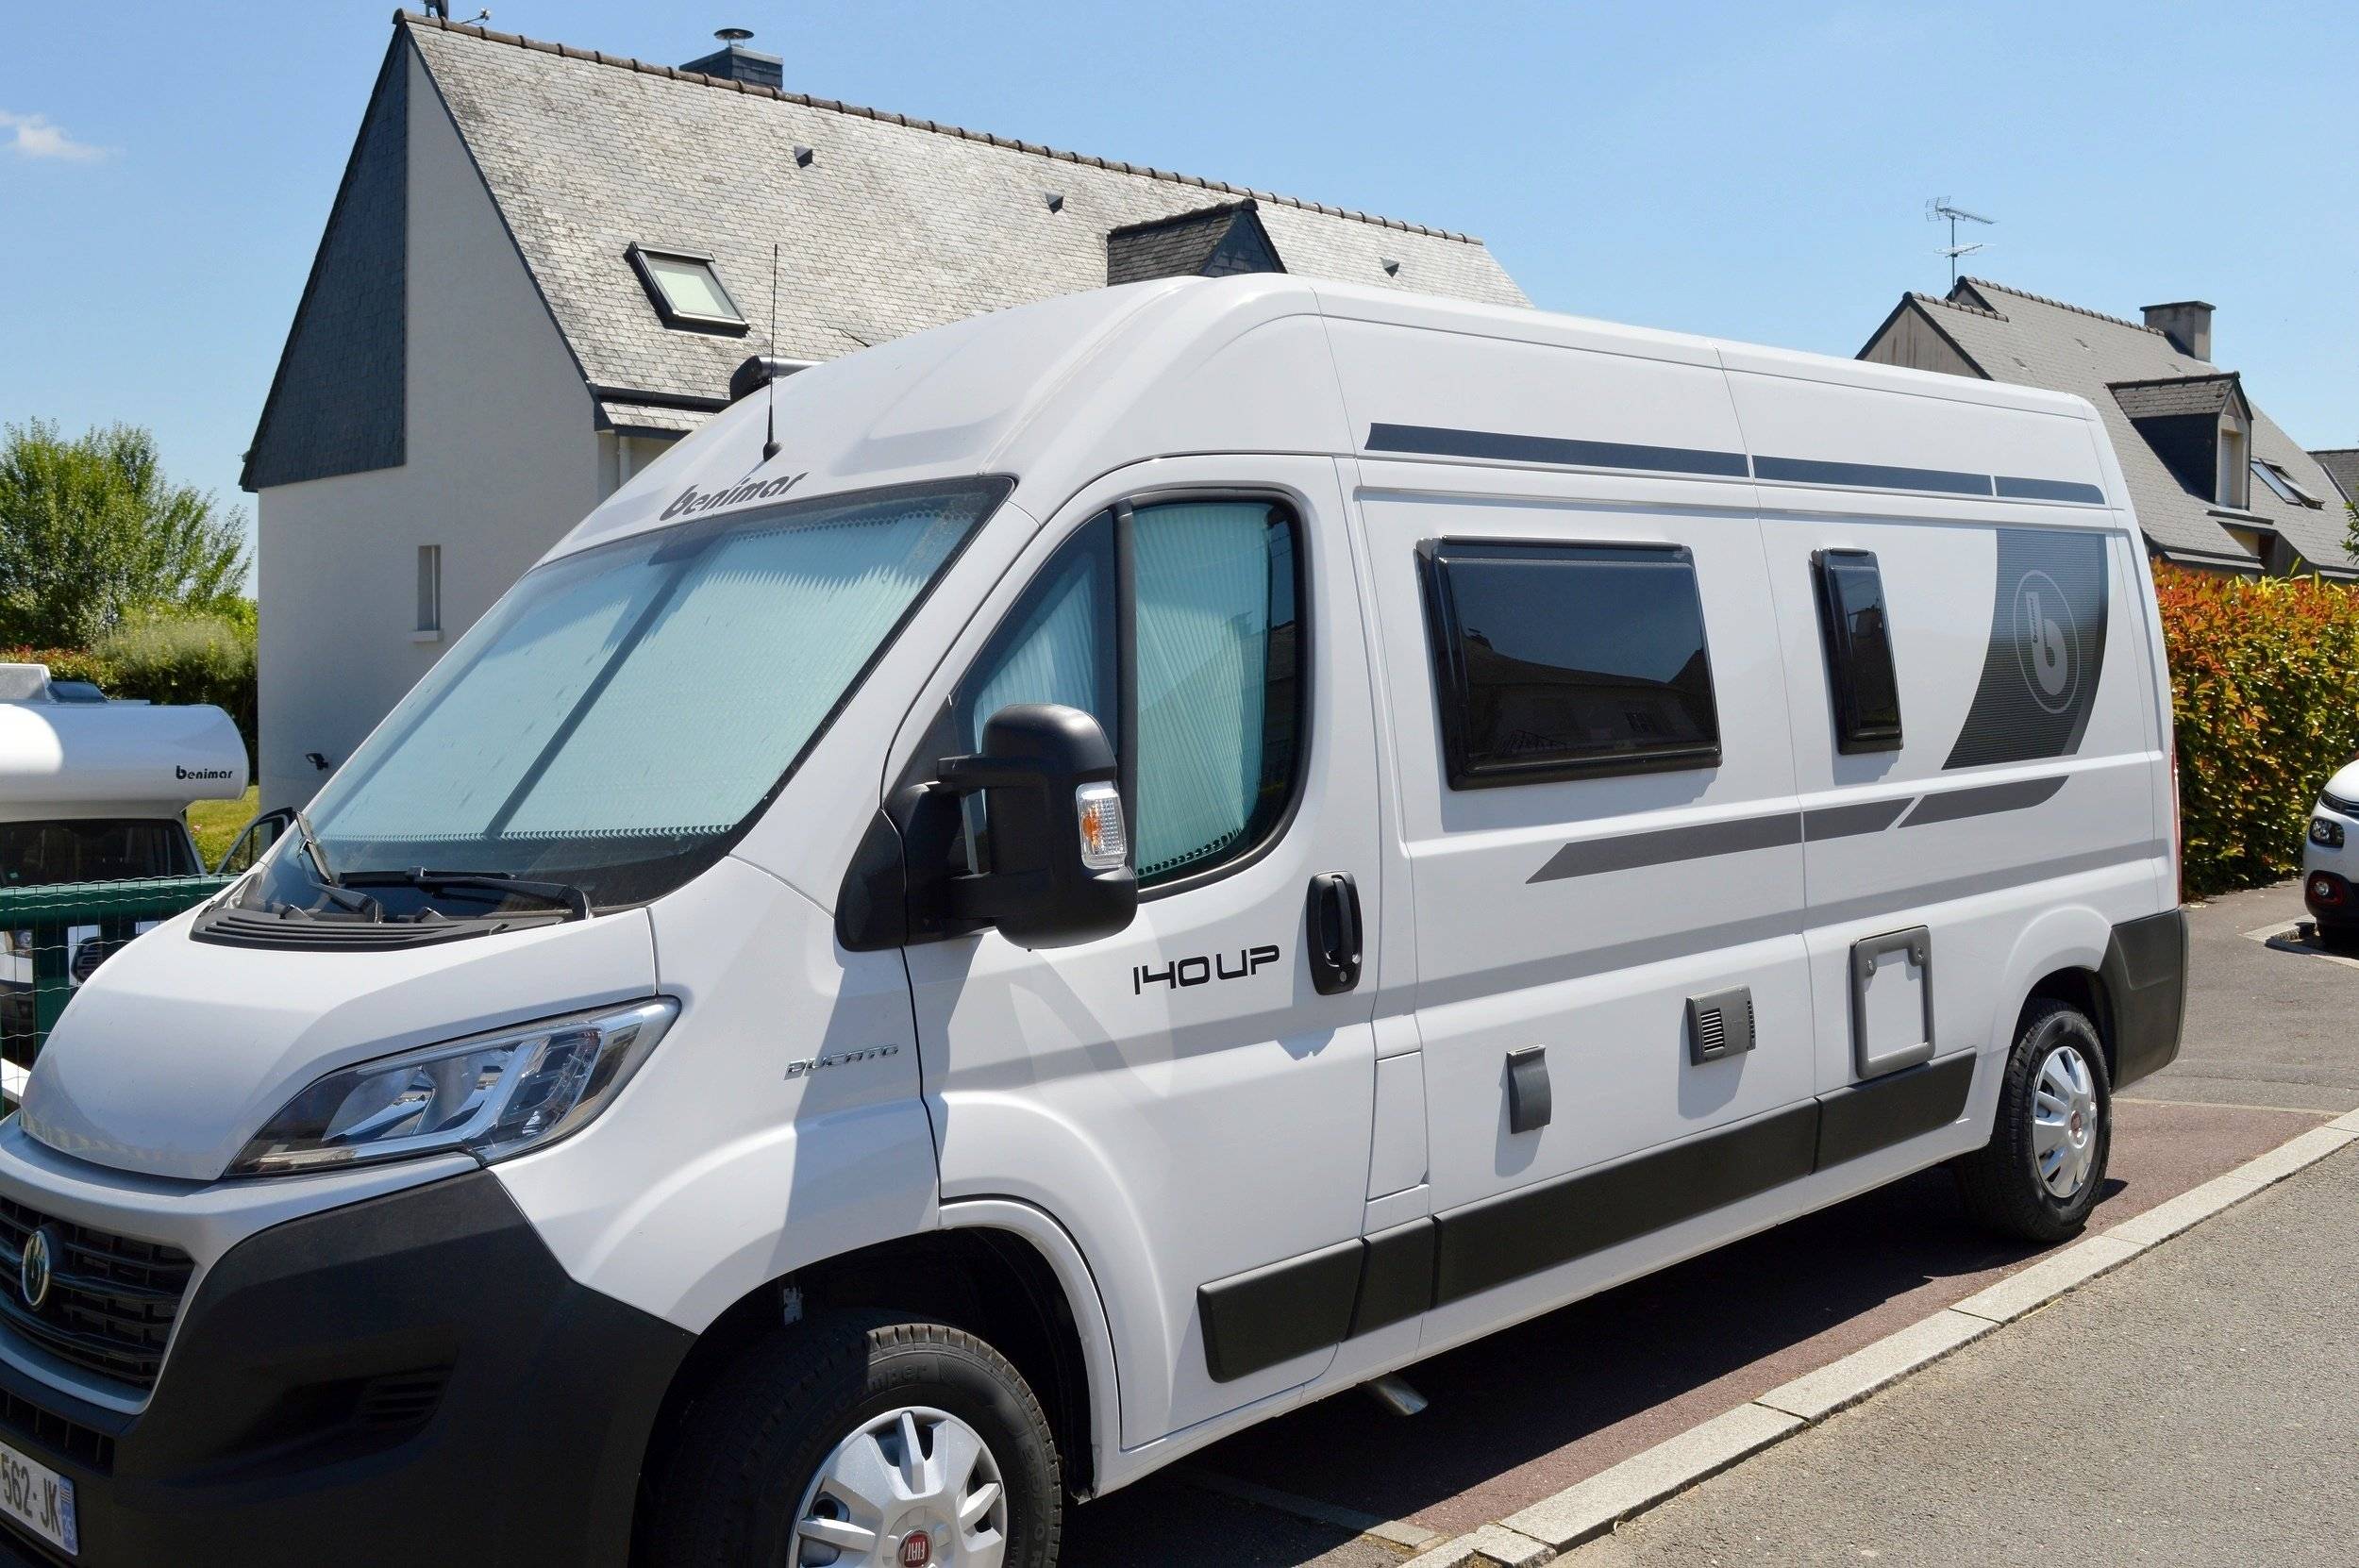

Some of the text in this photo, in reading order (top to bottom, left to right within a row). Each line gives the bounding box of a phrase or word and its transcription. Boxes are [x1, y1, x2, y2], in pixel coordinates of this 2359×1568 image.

[660, 472, 809, 521] benimar
[176, 765, 232, 779] benimar
[1133, 944, 1280, 995] 140 UP
[784, 1043, 898, 1077] DUCATO
[906, 1541, 926, 1561] FIAT
